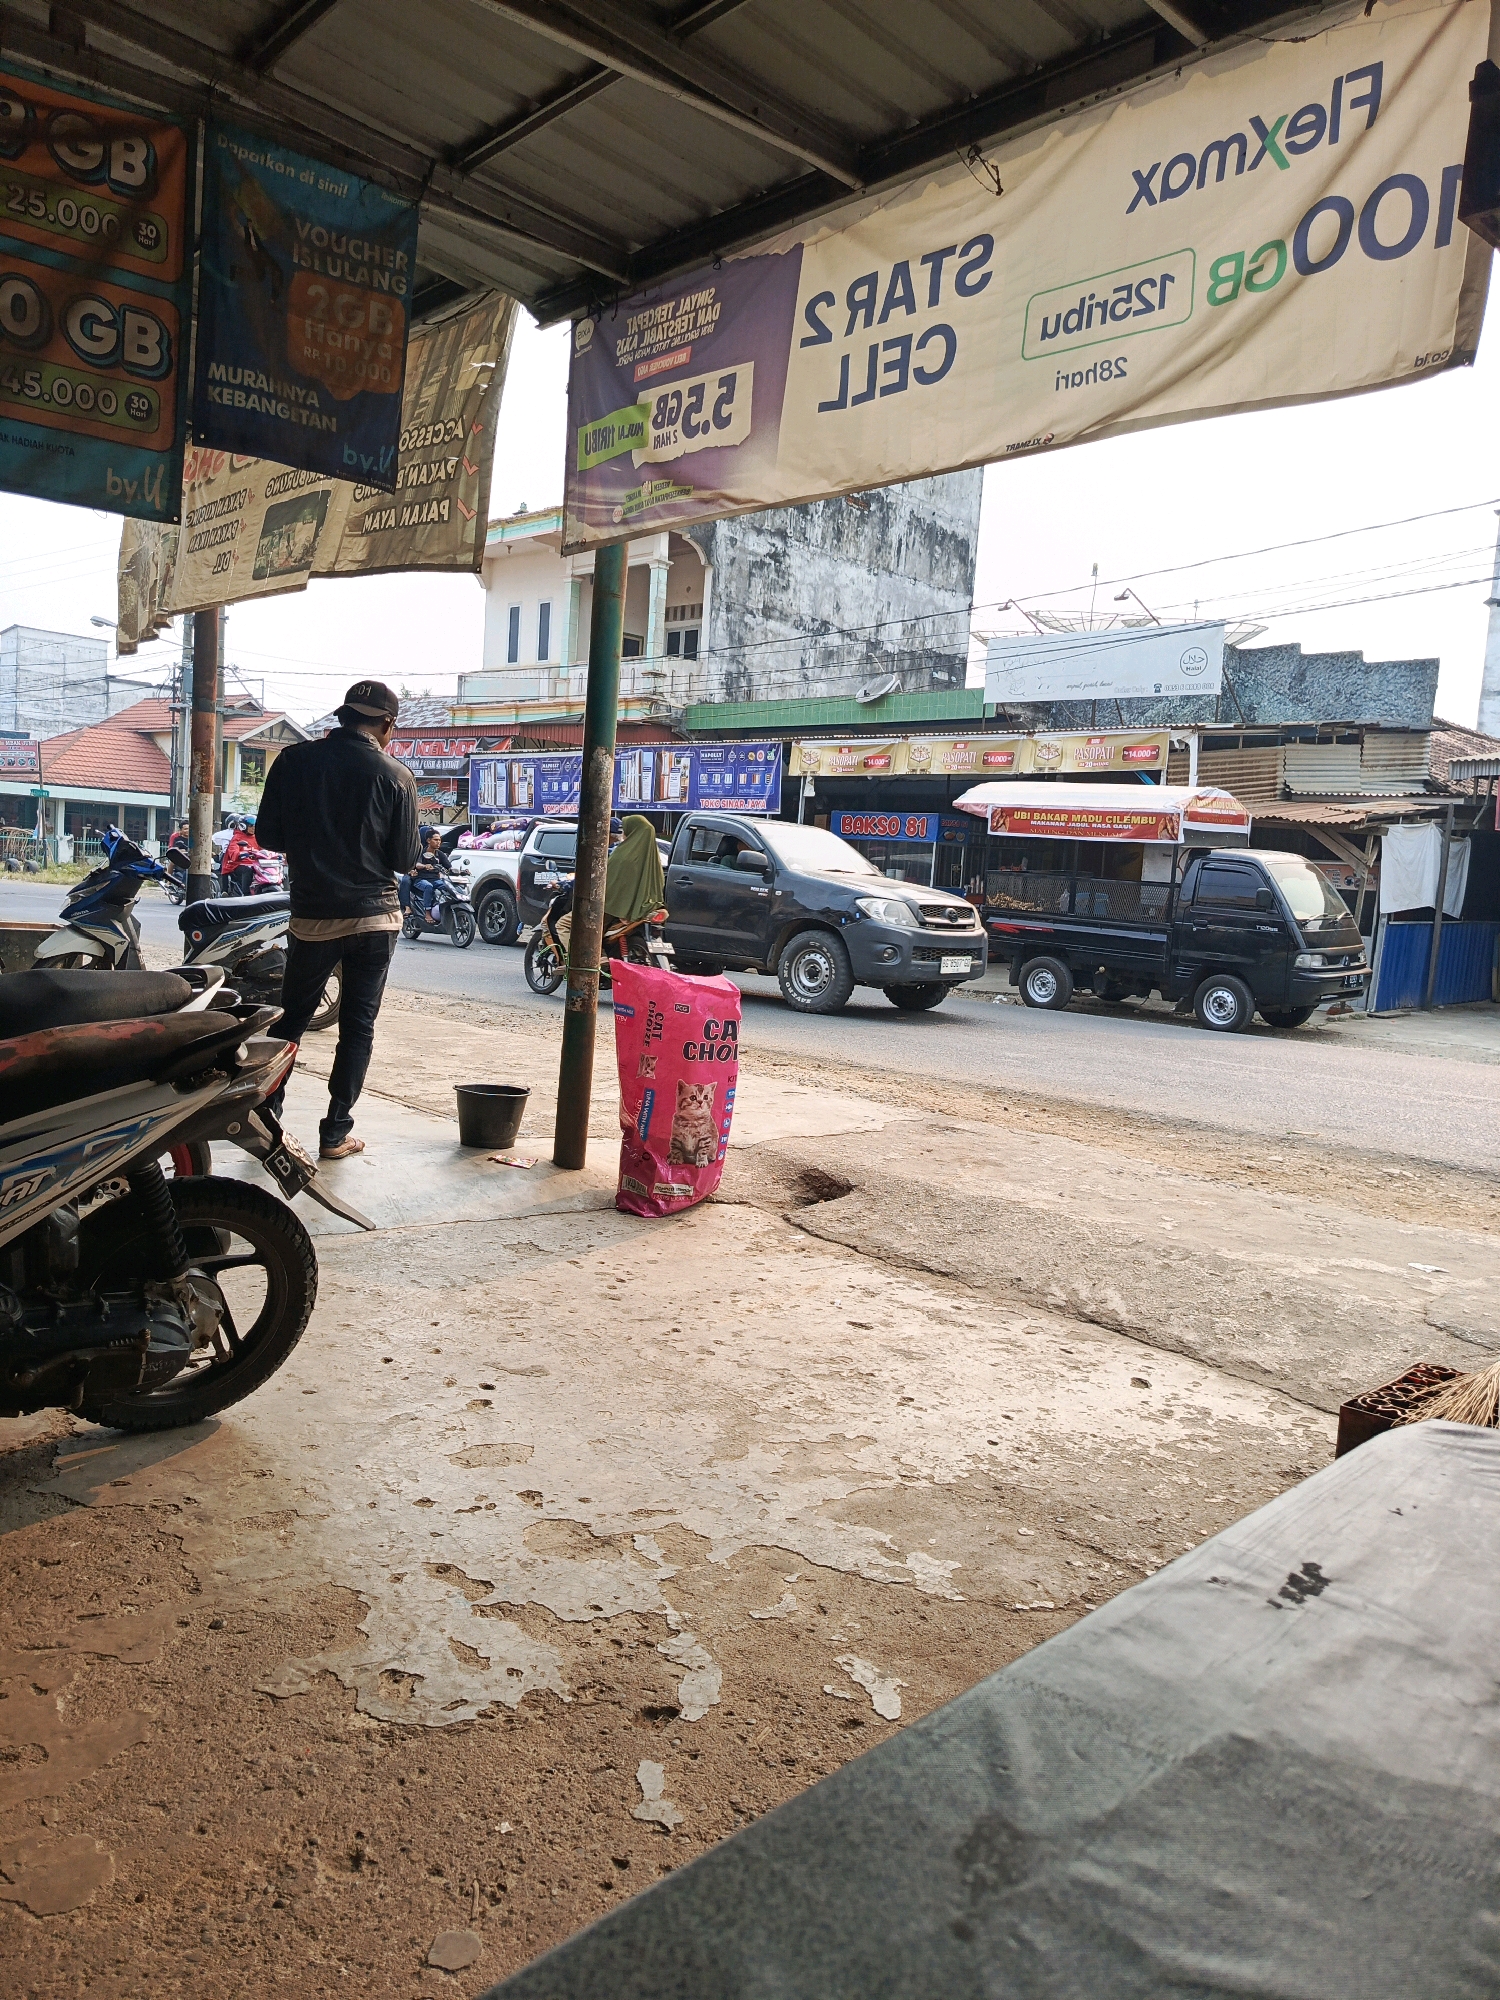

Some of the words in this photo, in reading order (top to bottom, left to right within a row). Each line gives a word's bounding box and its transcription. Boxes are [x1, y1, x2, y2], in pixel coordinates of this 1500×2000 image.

[50, 113, 148, 187] GB
[138, 222, 158, 239] 30
[138, 236, 155, 248] Hari
[295, 217, 409, 273] VOUCHER
[327, 260, 408, 295] ULANG
[66, 299, 162, 368] GB
[304, 318, 394, 362] Hanya
[207, 361, 321, 408] MURAHNYA
[130, 395, 149, 412] 30
[130, 409, 147, 420] Hari
[207, 384, 338, 433] KEBANGETAN
[828, 755, 859, 766] PASOPATI
[941, 752, 977, 763] PASOPATI
[1074, 746, 1115, 760] PASOPATI
[700, 799, 721, 810] TOKO
[721, 799, 746, 810] SINAR
[840, 814, 900, 837] BAKSO
[905, 816, 927, 838] 81
[1013, 811, 1030, 820] UBI
[1033, 812, 1068, 822] BAKAR
[1072, 814, 1103, 824] MADU
[1106, 815, 1157, 825] CILEMBU
[651, 1012, 664, 1042] CAT
[274, 1155, 290, 1177] B
